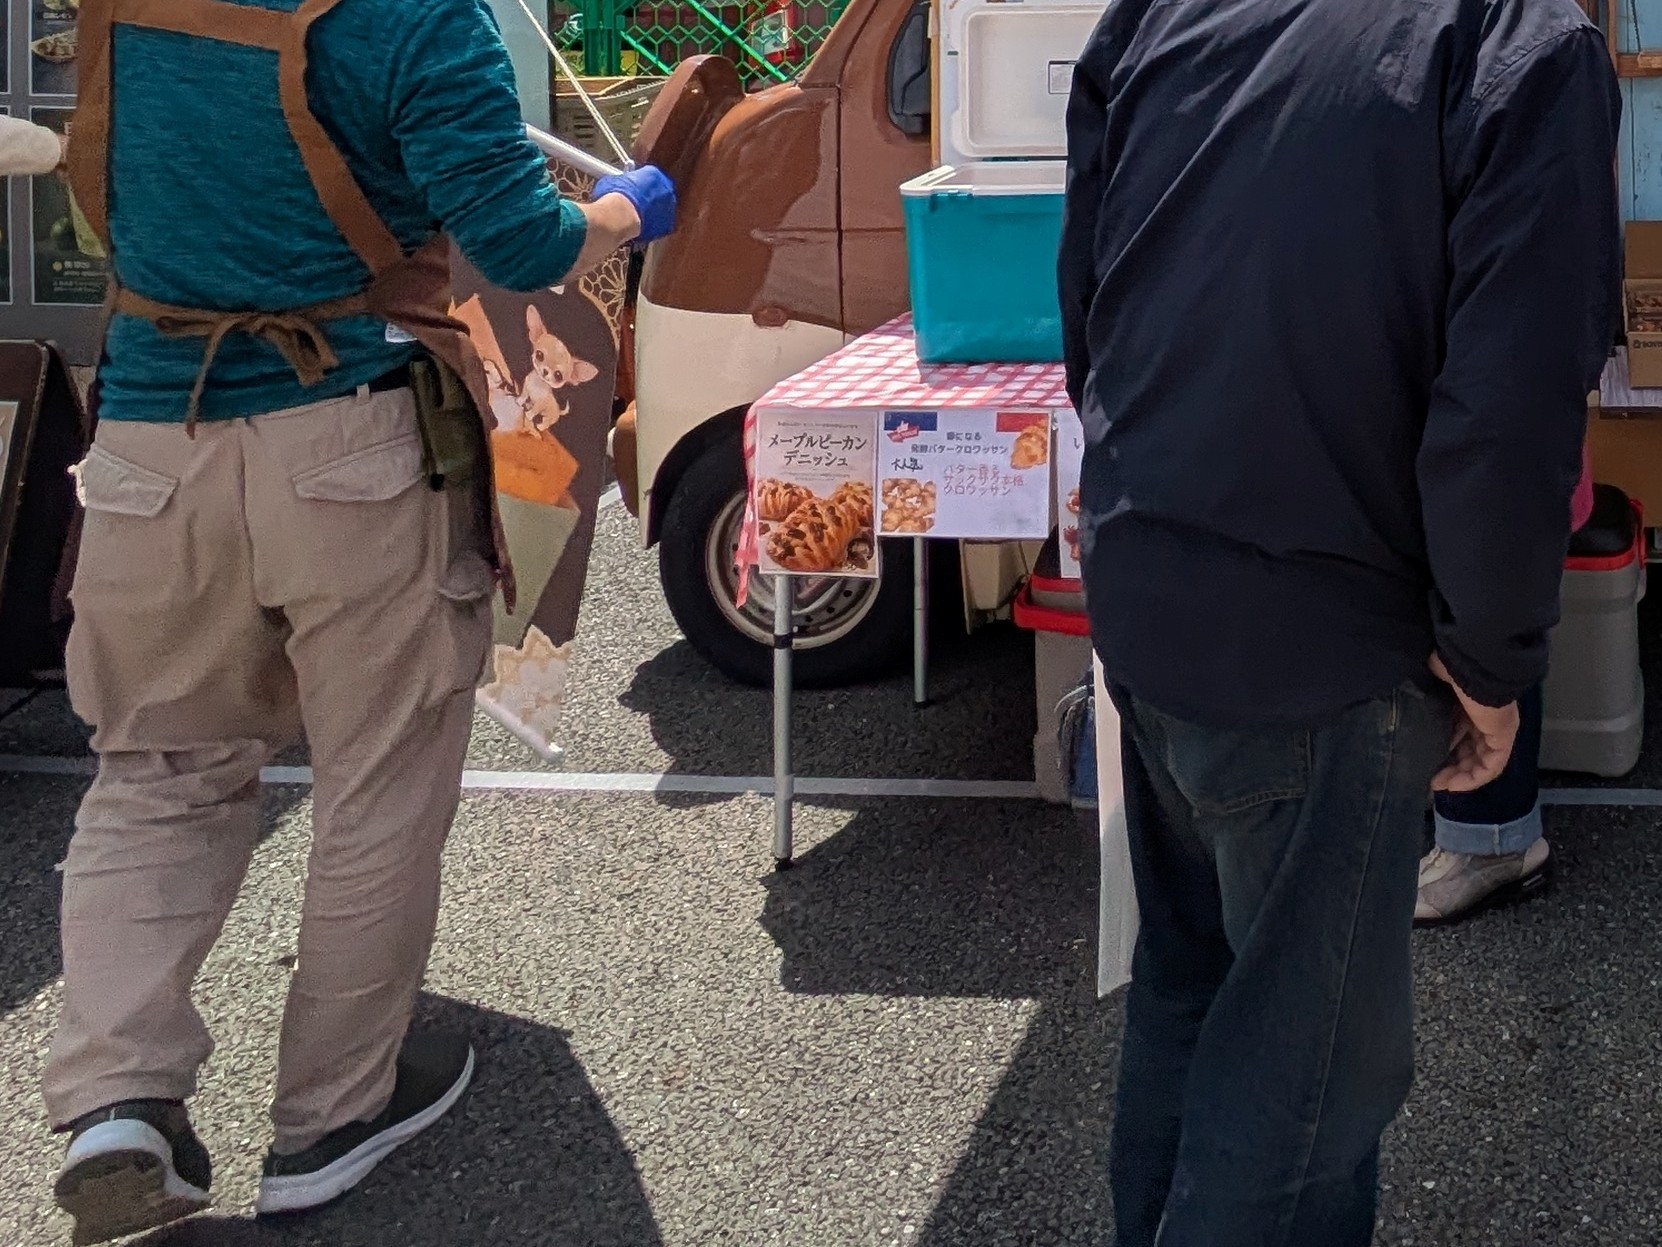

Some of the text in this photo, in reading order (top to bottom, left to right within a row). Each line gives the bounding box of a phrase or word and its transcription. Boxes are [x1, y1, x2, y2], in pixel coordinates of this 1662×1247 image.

[768, 432, 868, 451] メープルピーカン
[784, 450, 848, 467] デニッシュ
